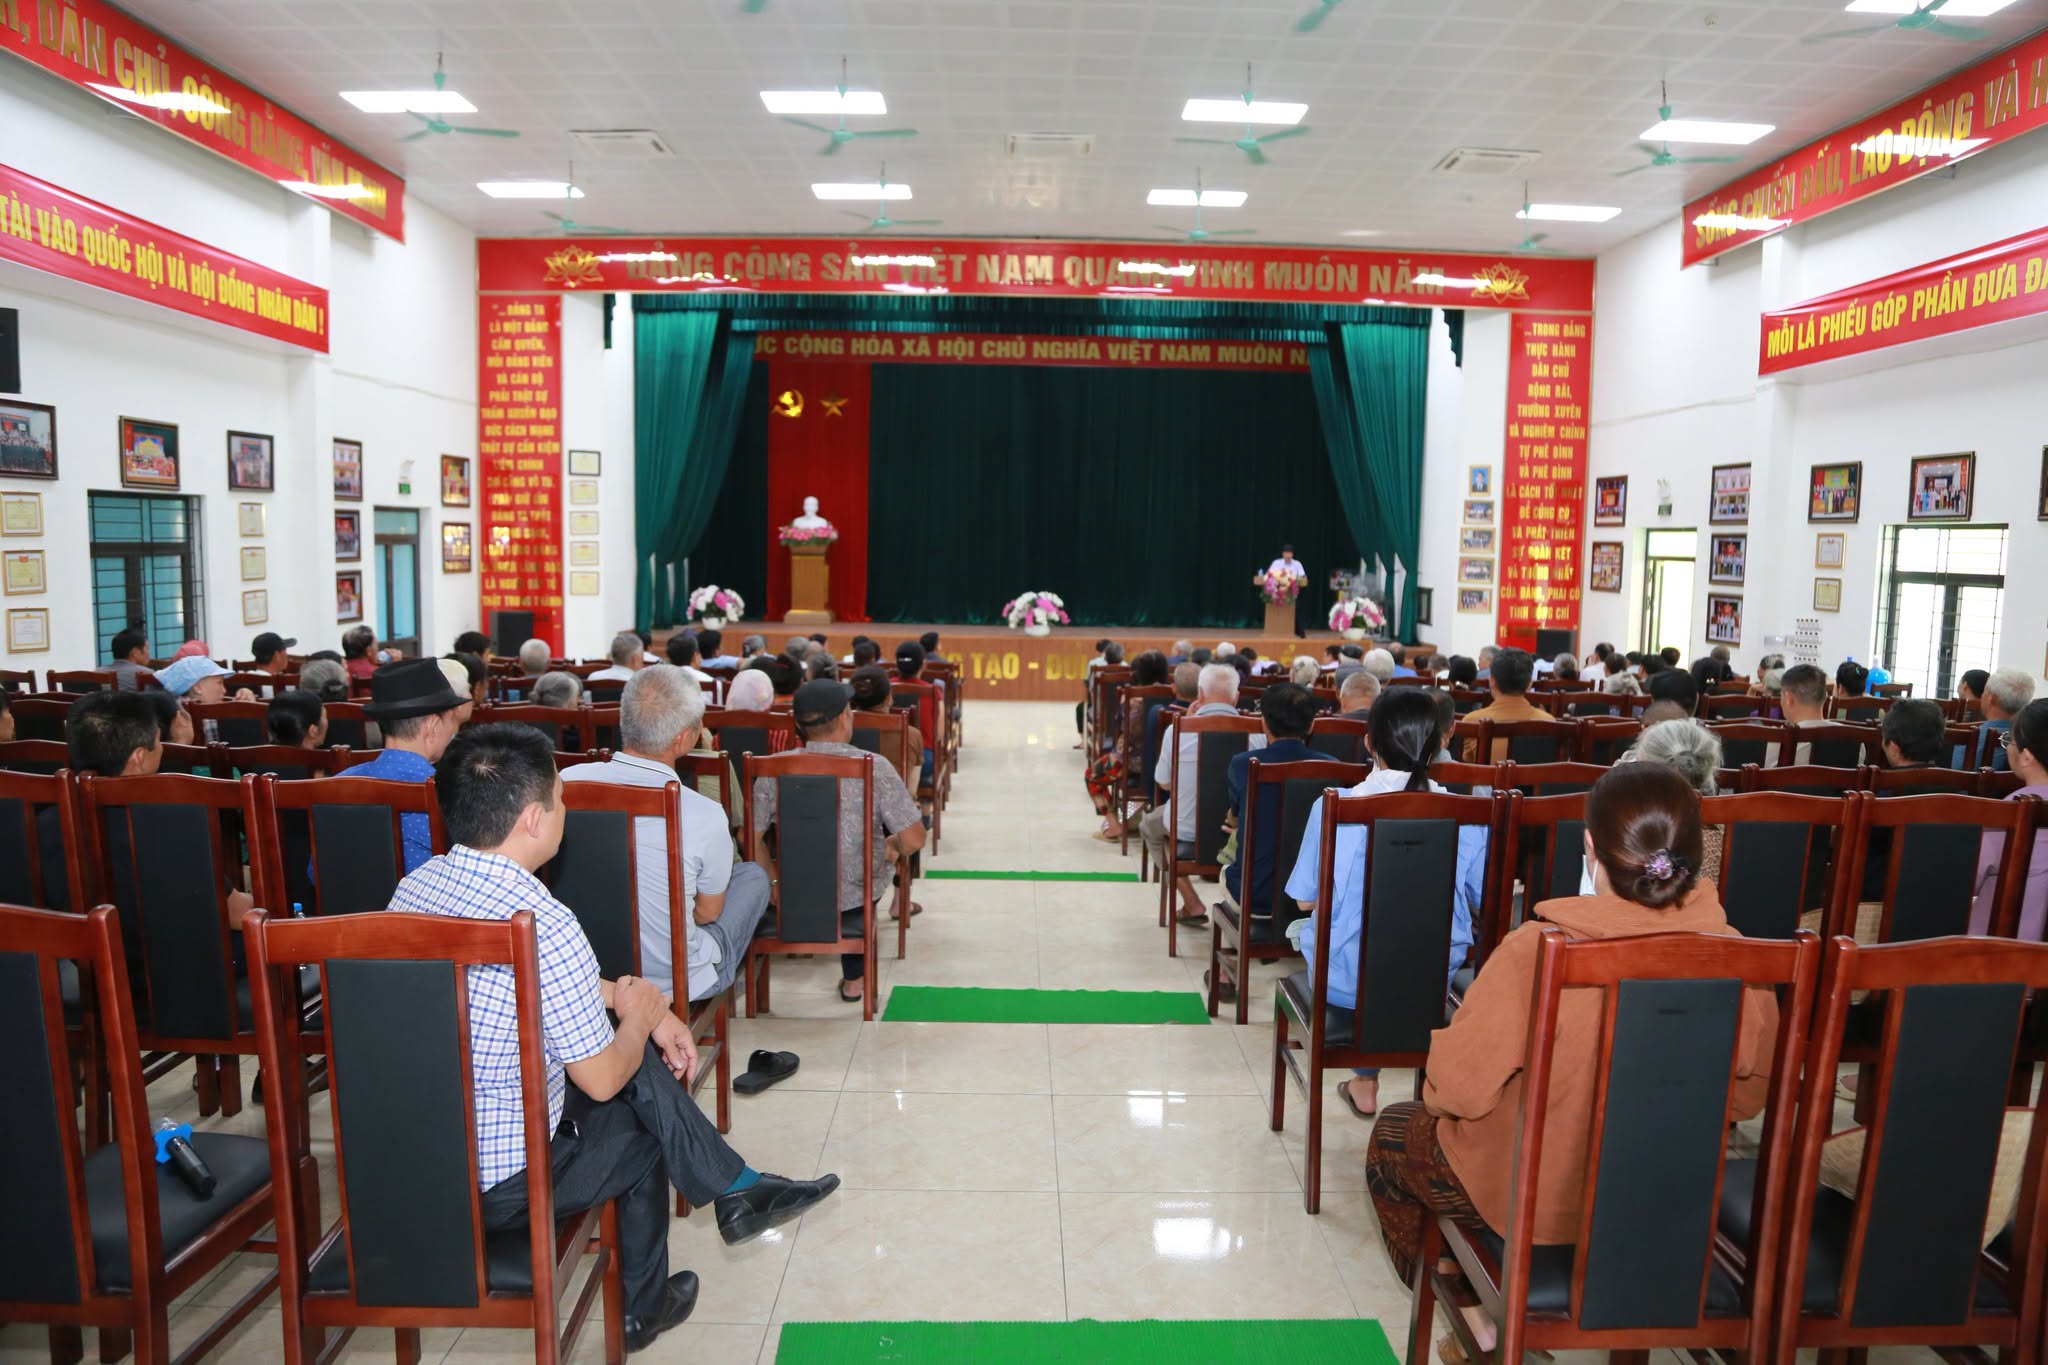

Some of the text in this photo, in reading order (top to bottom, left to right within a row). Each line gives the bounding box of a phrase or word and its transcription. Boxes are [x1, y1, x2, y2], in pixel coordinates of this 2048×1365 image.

[38, 0, 108, 78] DÂN
[182, 73, 246, 148] CÔNG
[1801, 141, 1843, 206] ĐẤU,
[1850, 127, 1894, 185] LAO
[1899, 91, 1974, 167] ĐỘNG
[0, 190, 32, 241] TÀI
[36, 206, 77, 256] VÀO
[82, 223, 131, 273] QUỐC
[135, 241, 164, 289] HỘI
[166, 251, 188, 292] VÀ
[190, 260, 215, 306] HỘI
[218, 267, 255, 313] ĐỒNG
[257, 287, 291, 325] NHÂN
[724, 244, 810, 287] CỘNG
[821, 242, 889, 282] SẢN
[898, 246, 967, 289] VIỆT
[976, 254, 1054, 284] NAM
[1063, 256, 1171, 287] QUANG
[1180, 256, 1254, 289] VINH
[1264, 255, 1358, 292] MUÔN
[1369, 258, 1444, 295] NĂM
[784, 334, 844, 357] CỘNG
[901, 335, 931, 356] XÃ
[938, 337, 975, 360] HỘI
[981, 336, 1026, 358] CHỦ
[1033, 338, 1101, 360] NGHĨA
[1108, 340, 1154, 364] VIỆT
[1160, 344, 1210, 362] NAM
[1218, 342, 1283, 365] MUÔN
[1767, 312, 1794, 358] MỖI
[1797, 312, 1815, 350] LÁ
[1819, 298, 1867, 345] PHIẾU
[1871, 292, 1907, 333] GÓP
[1911, 271, 1968, 322] PHẦN
[1972, 263, 2018, 308] ĐƯA
[971, 652, 1020, 686] TẠO
